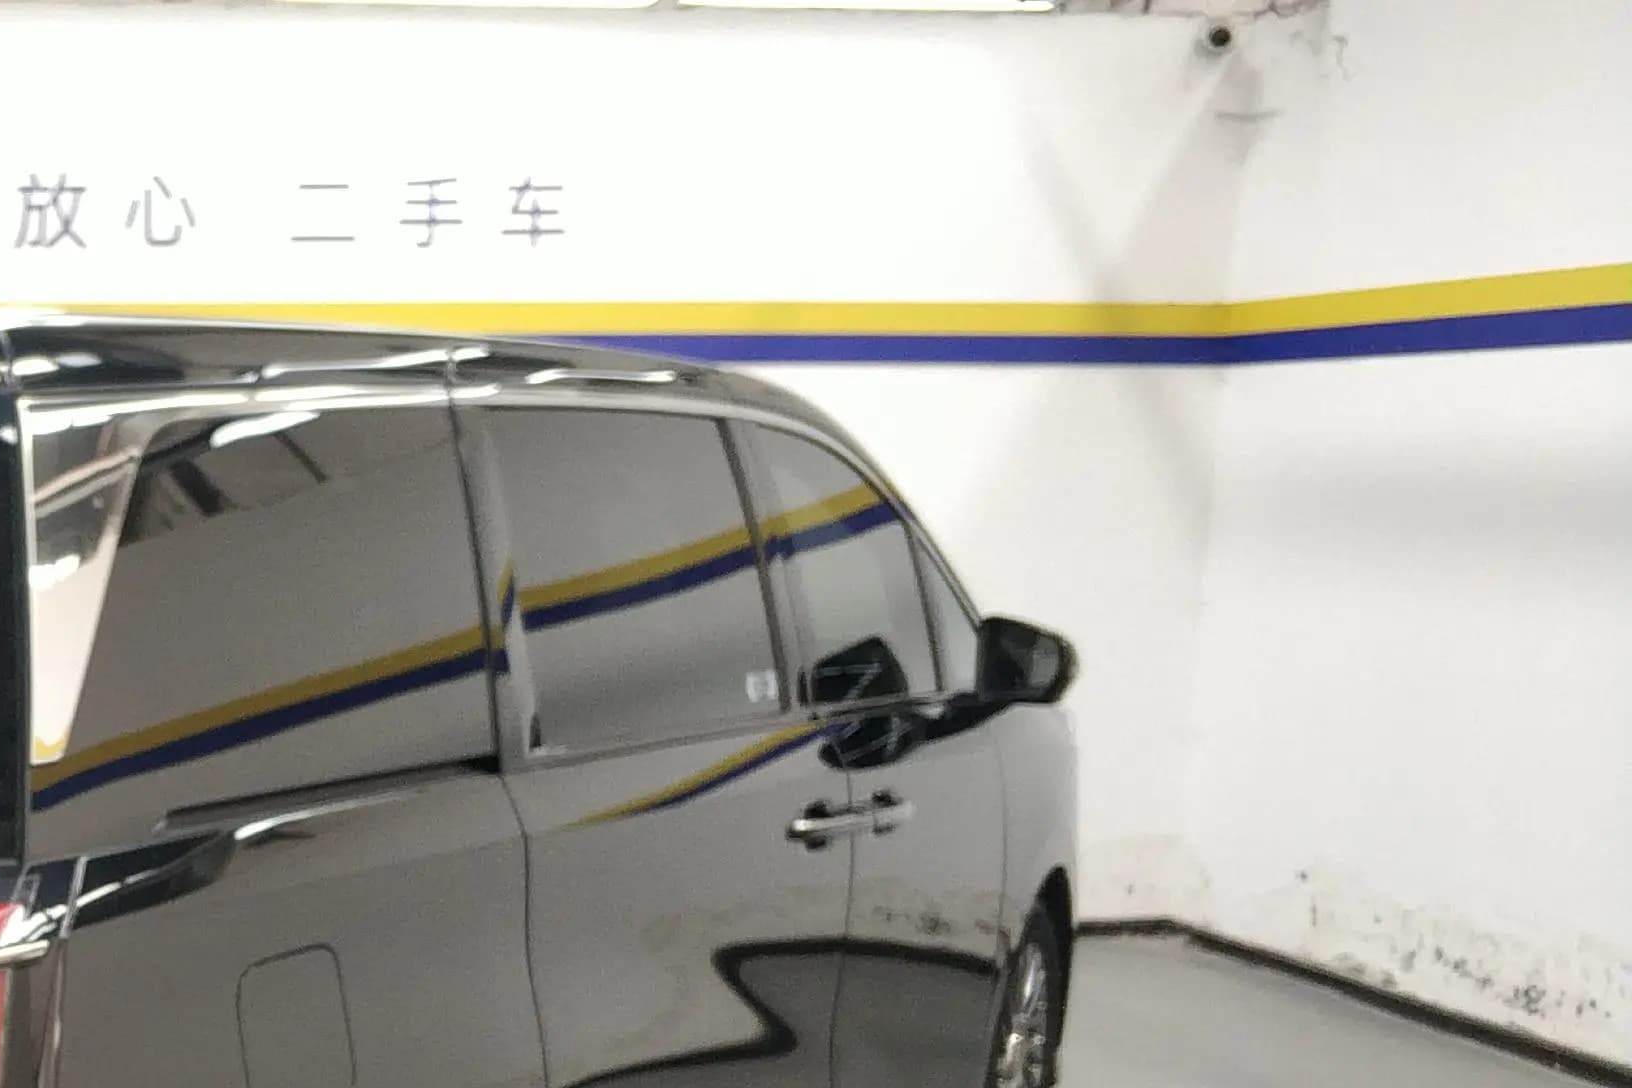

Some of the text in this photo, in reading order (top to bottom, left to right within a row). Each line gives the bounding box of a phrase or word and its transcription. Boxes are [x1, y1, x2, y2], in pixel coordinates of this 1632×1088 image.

[14, 173, 196, 250] 放心
[290, 177, 566, 249] 二手车
